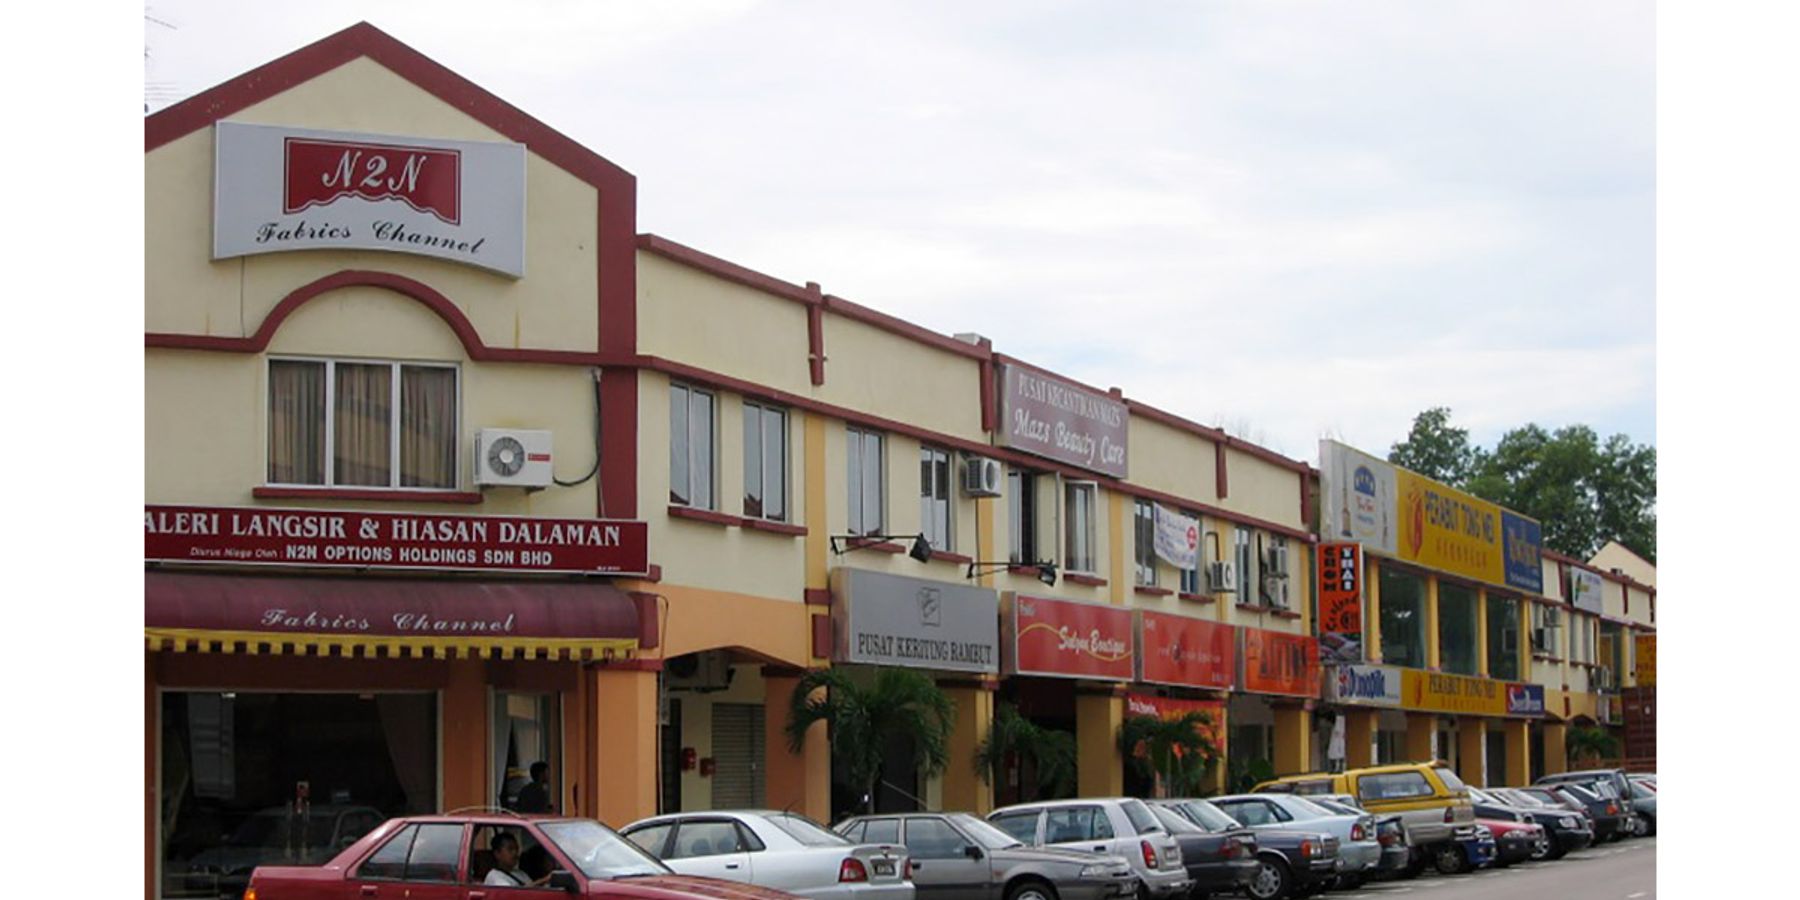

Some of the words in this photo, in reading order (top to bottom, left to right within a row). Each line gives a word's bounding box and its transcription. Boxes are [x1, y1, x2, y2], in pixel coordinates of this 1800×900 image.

[321, 150, 427, 193] N2N
[256, 220, 352, 243] Fabrics
[372, 220, 486, 255] Channel
[1055, 421, 1095, 465] Beauty
[1101, 435, 1124, 465] Care
[232, 514, 346, 539] LANGSIR
[359, 517, 380, 539] &
[391, 518, 487, 543] HIASAN
[499, 522, 621, 547] DALAMAN
[286, 545, 317, 560] N2N
[324, 546, 393, 561] OPTIONS
[399, 547, 476, 563] HOLDINGS
[484, 550, 514, 564] SDN
[520, 551, 552, 565] BHD
[261, 608, 370, 630] Fabrics
[392, 611, 515, 632] Channel
[858, 633, 894, 657] PUSAT
[896, 637, 949, 661] KERITING
[951, 642, 992, 665] RAMBUT
